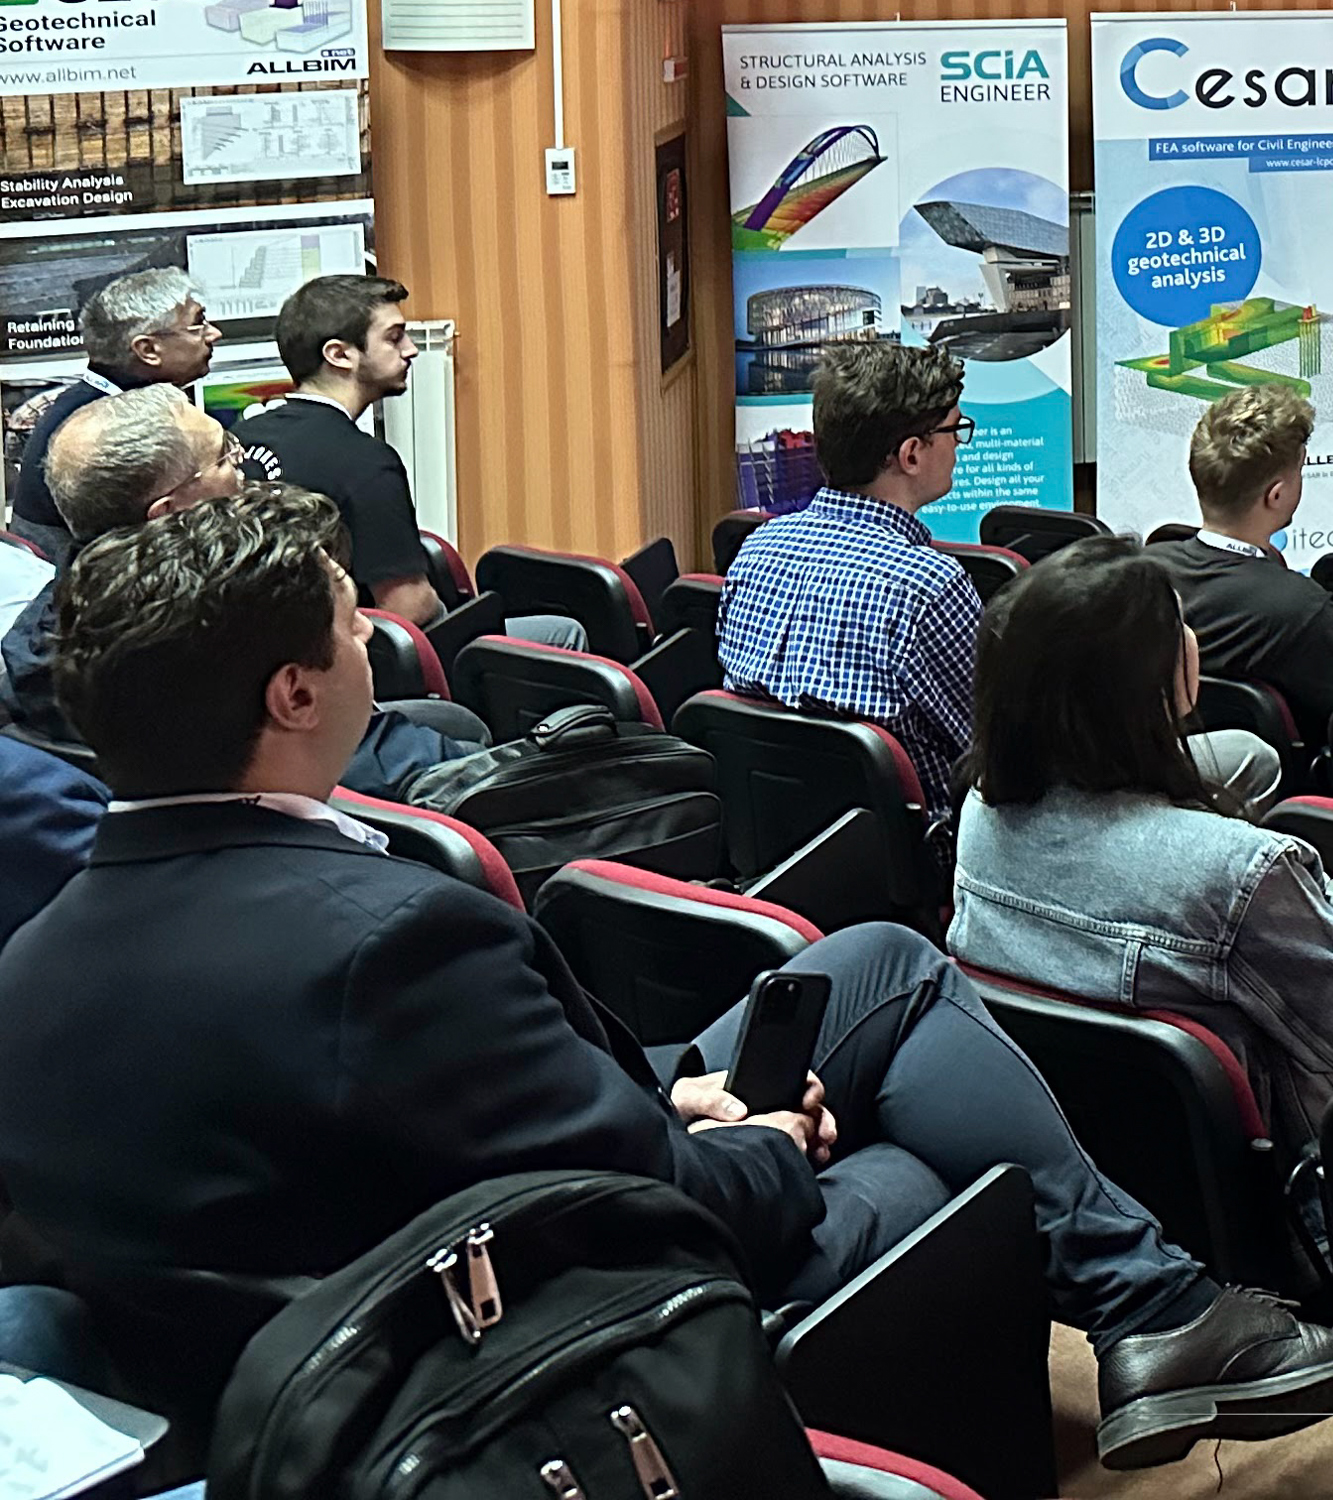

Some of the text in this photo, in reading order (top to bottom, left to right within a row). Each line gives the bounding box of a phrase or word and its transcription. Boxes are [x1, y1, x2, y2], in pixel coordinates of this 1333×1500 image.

[247, 59, 356, 75] ALLBIM
[740, 52, 926, 69] STRUCTURAL ANALYSIS
[740, 72, 907, 89] & DESIGN SOFTWARE
[941, 84, 1050, 102] ENGINEER
[1156, 142, 1178, 153] FEA
[1182, 140, 1234, 154] software
[1237, 140, 1254, 152] for
[1258, 138, 1283, 151] Civil
[0, 174, 124, 192] Stability Analysis
[1, 190, 133, 209] Excavation Design
[1146, 226, 1225, 248] 2D & 3D
[1128, 243, 1246, 275] geotechnical
[1151, 266, 1226, 289] analysis
[7, 318, 75, 334] Retaining
[976, 437, 1044, 448] multi-material
[962, 451, 1014, 464] and design
[966, 463, 980, 474] for
[982, 462, 994, 473] all
[997, 462, 1021, 472] kinds
[974, 474, 1007, 486] Design
[1009, 474, 1021, 484] all
[1023, 474, 1045, 486] your
[963, 487, 993, 499] within
[996, 485, 1010, 496] the
[1013, 486, 1038, 496] same
